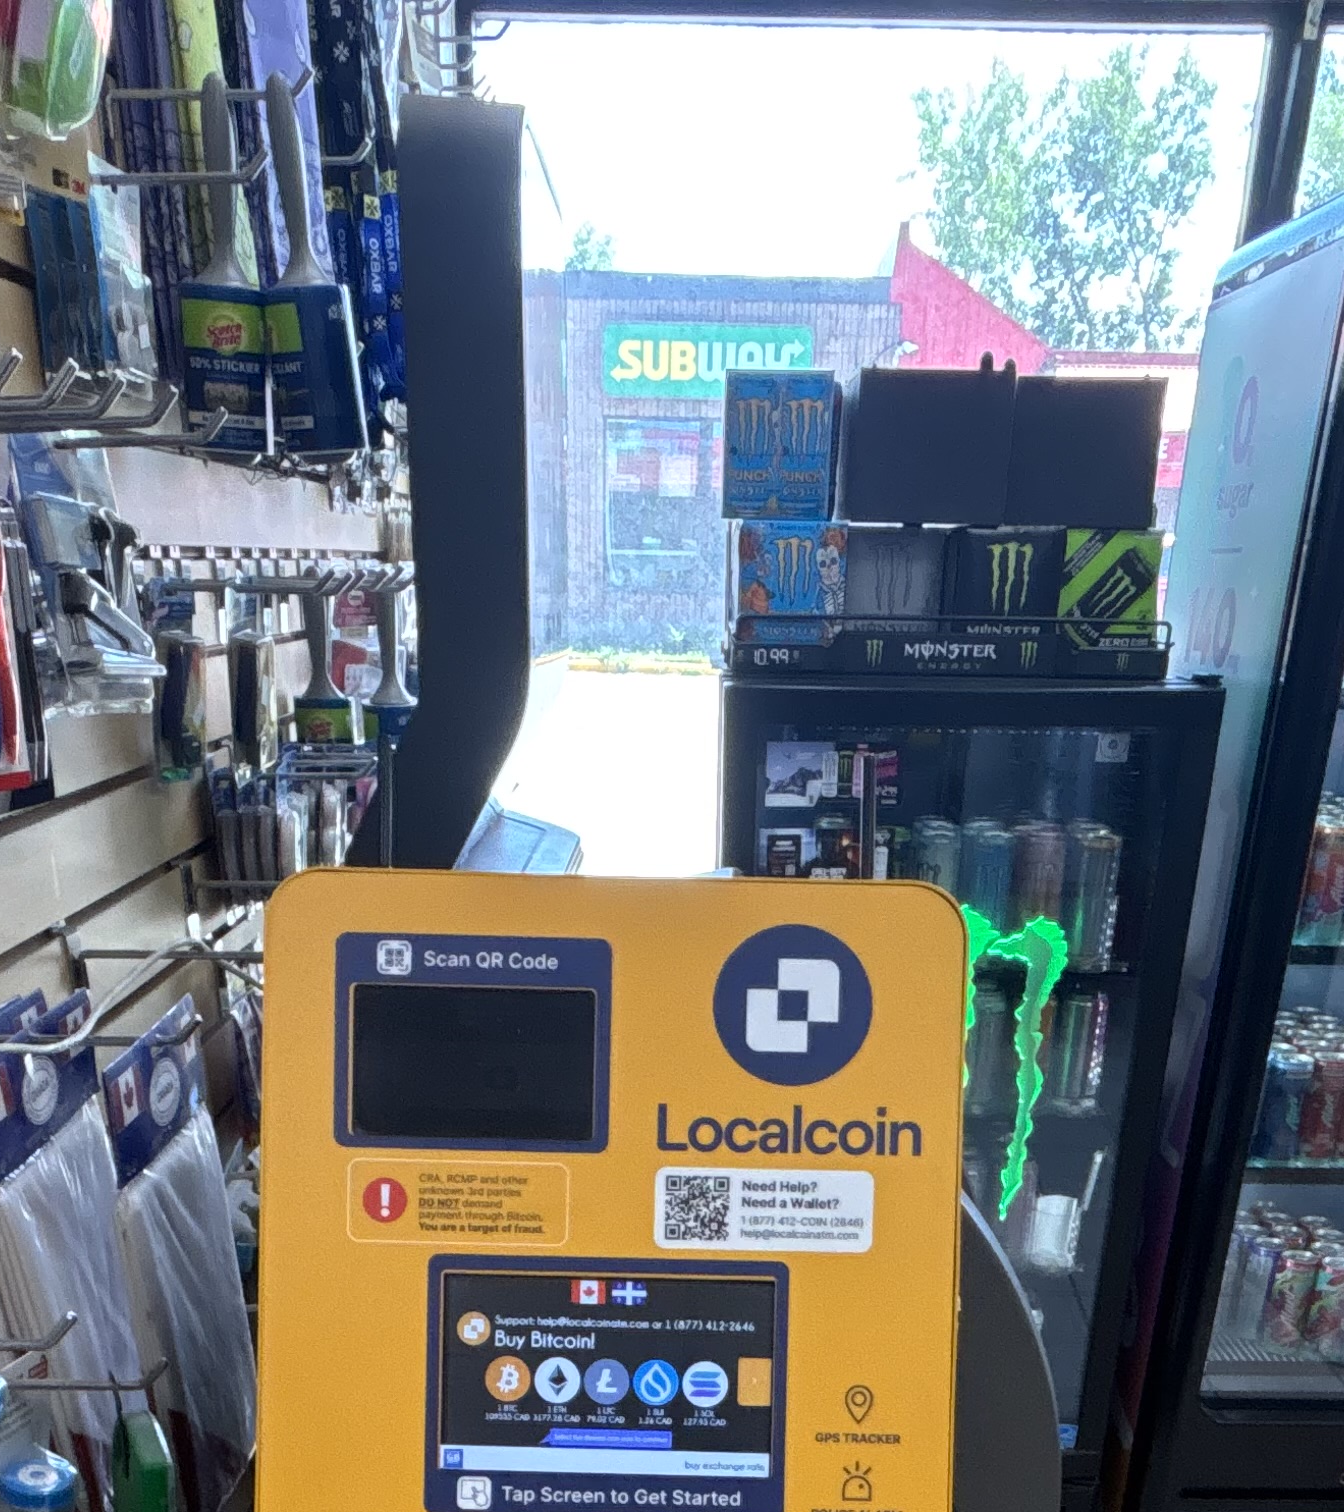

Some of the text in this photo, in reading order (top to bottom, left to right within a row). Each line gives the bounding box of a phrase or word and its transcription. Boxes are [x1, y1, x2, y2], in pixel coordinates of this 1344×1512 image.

[369, 237, 382, 294] OXBAR
[610, 339, 805, 383] SUBWAY
[904, 641, 997, 660] MONSTER
[423, 950, 559, 970] Scan QR Code
[657, 1103, 922, 1156] Localcoin
[447, 1174, 478, 1184] RCMP
[480, 1175, 499, 1185] and
[502, 1176, 529, 1185] other
[418, 1186, 465, 1196] unknown
[486, 1188, 522, 1199] parties
[742, 1180, 818, 1194] Need Help?
[418, 1198, 503, 1209] DO NOT demand
[741, 1197, 840, 1210] Need a Wallet?
[418, 1210, 462, 1221] payment
[464, 1211, 505, 1223] through
[749, 1216, 775, 1227] (877)
[778, 1217, 828, 1226] 412-COIN
[419, 1222, 438, 1231] You
[440, 1224, 457, 1232] are
[468, 1223, 499, 1234] target
[501, 1223, 512, 1233] of
[514, 1224, 545, 1234] fraud.
[740, 1229, 859, 1241] help@localcoinatm.com
[494, 1314, 536, 1327] Support:
[536, 1316, 649, 1329] help@localcoinatm.com
[651, 1320, 662, 1329] or
[673, 1319, 703, 1331] (877)
[706, 1320, 755, 1331] 412-2646
[494, 1330, 596, 1350] Buy Bitcoin!
[514, 1413, 530, 1422] CAD
[564, 1414, 581, 1423] CAD
[609, 1415, 626, 1424] CAD
[656, 1417, 673, 1426] CAD
[709, 1418, 727, 1427] CAD
[815, 1432, 901, 1444] GPS TRACKER
[684, 1460, 701, 1471] buy
[702, 1461, 746, 1473] exchange
[501, 1486, 741, 1507] Tap Screen to Get Started
